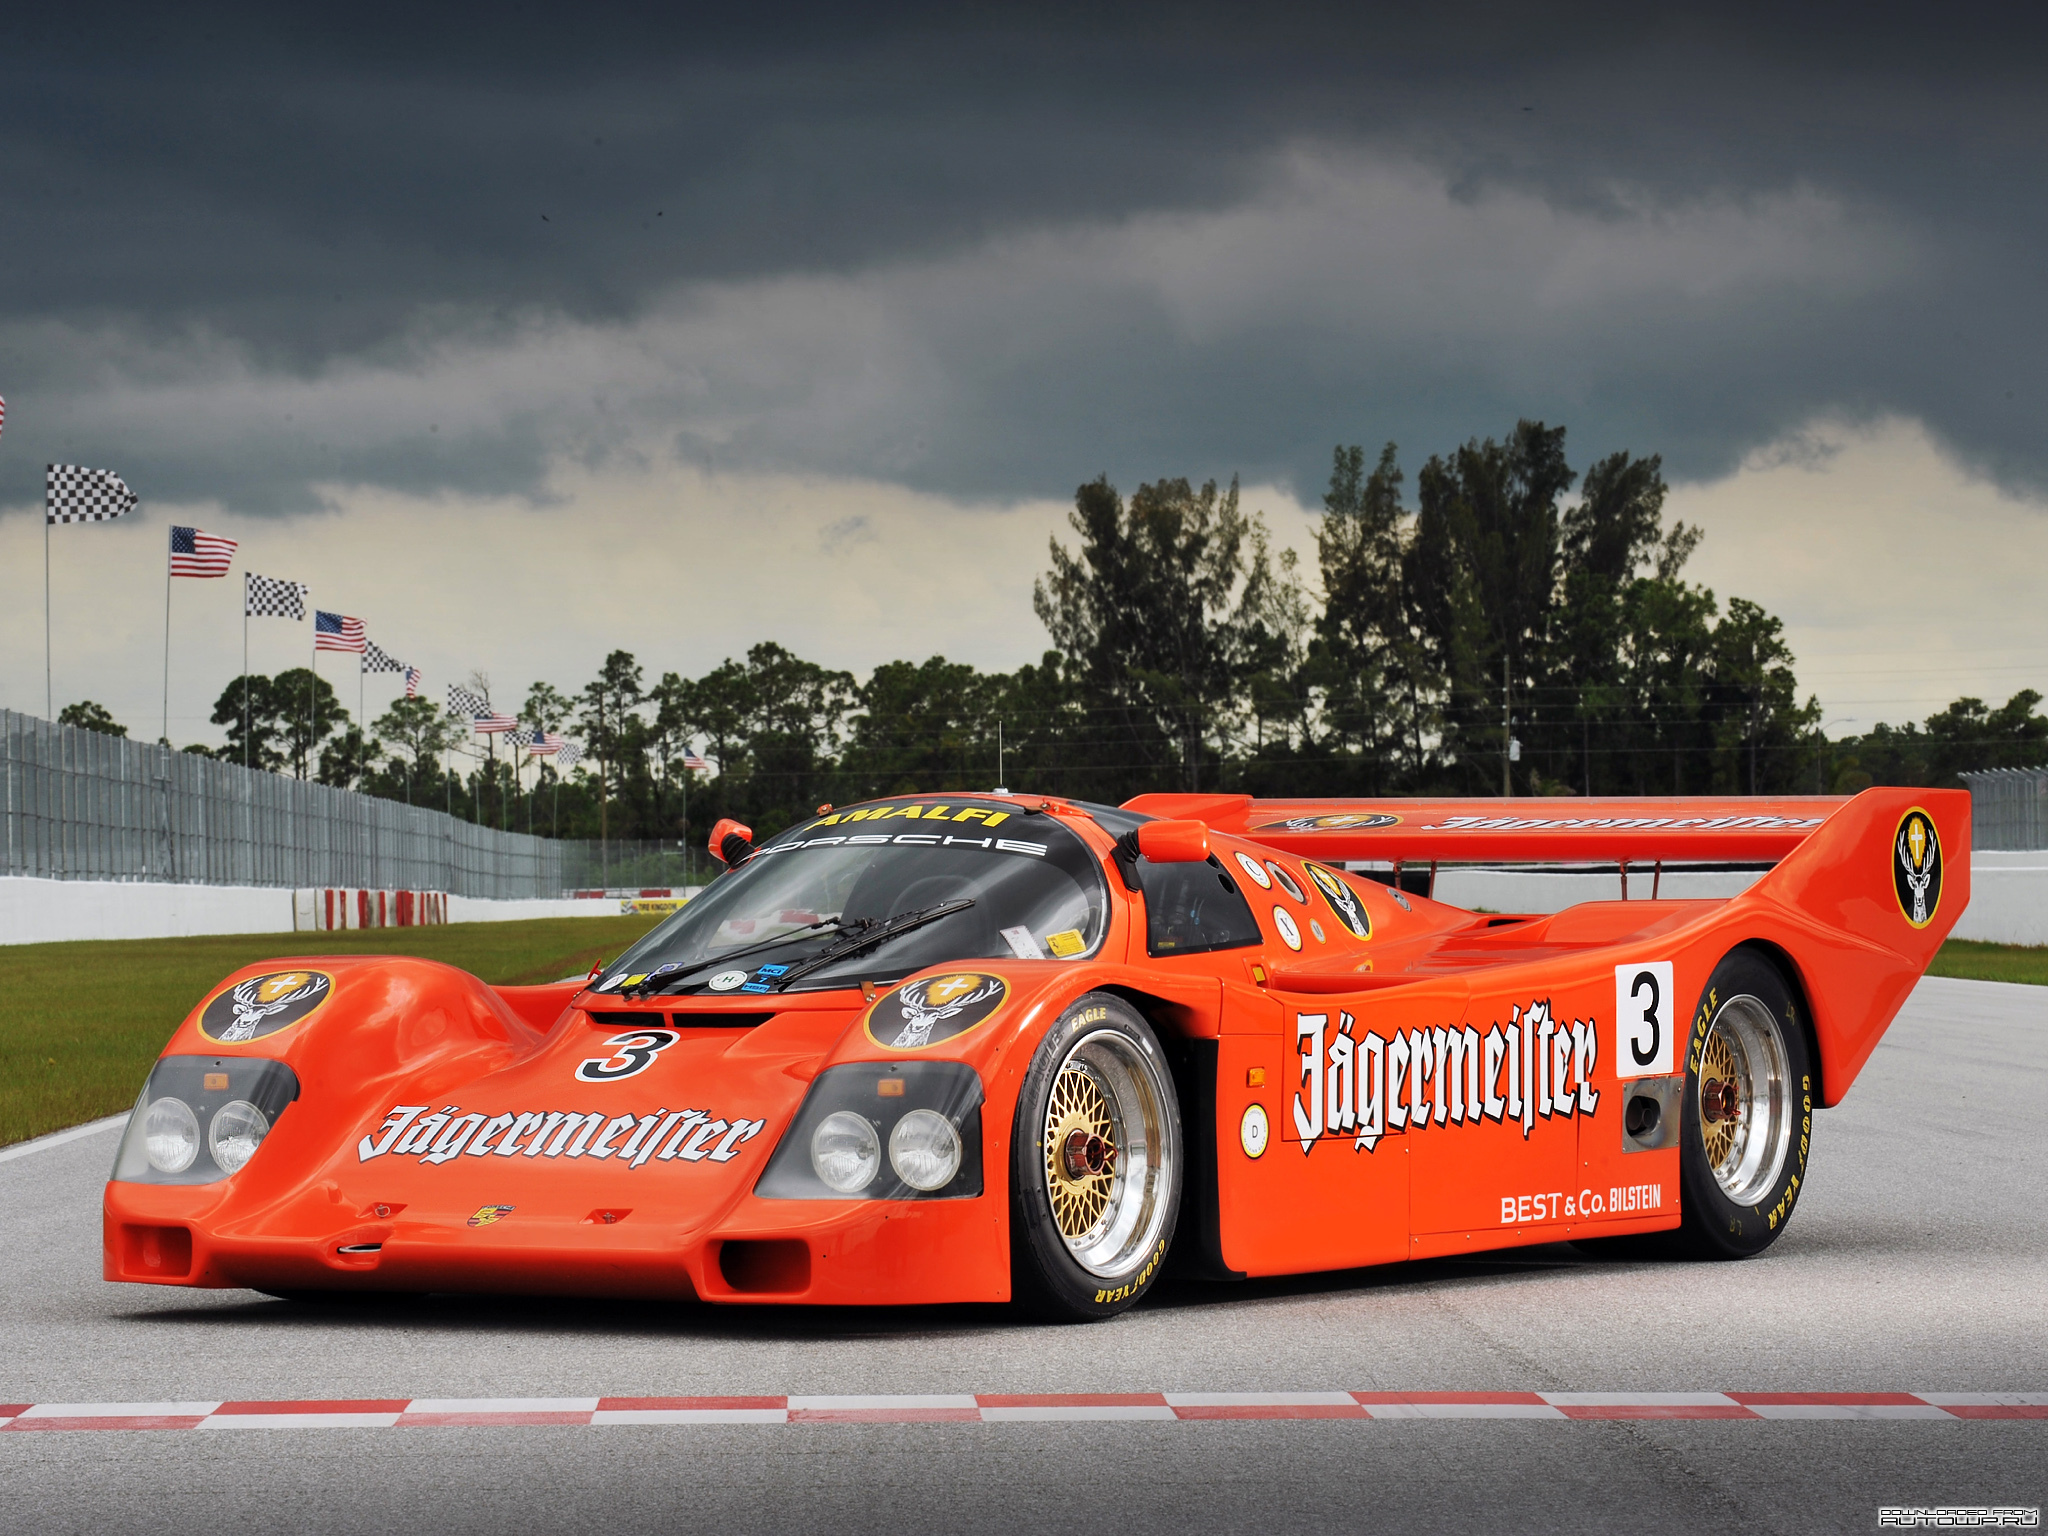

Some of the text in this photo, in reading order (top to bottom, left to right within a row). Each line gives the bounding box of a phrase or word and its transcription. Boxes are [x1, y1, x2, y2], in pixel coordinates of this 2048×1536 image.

[803, 805, 1011, 831] AMALFI
[735, 834, 1048, 865] PORSCHE
[651, 903, 678, 911] KINGDOM
[1071, 1007, 1107, 1032] EAGLE
[1630, 971, 1660, 1066] 3
[1689, 987, 1719, 1077] EAGLE
[574, 1029, 681, 1083] 3
[1500, 1184, 1661, 1224] BEST & Co. BILSTEIN
